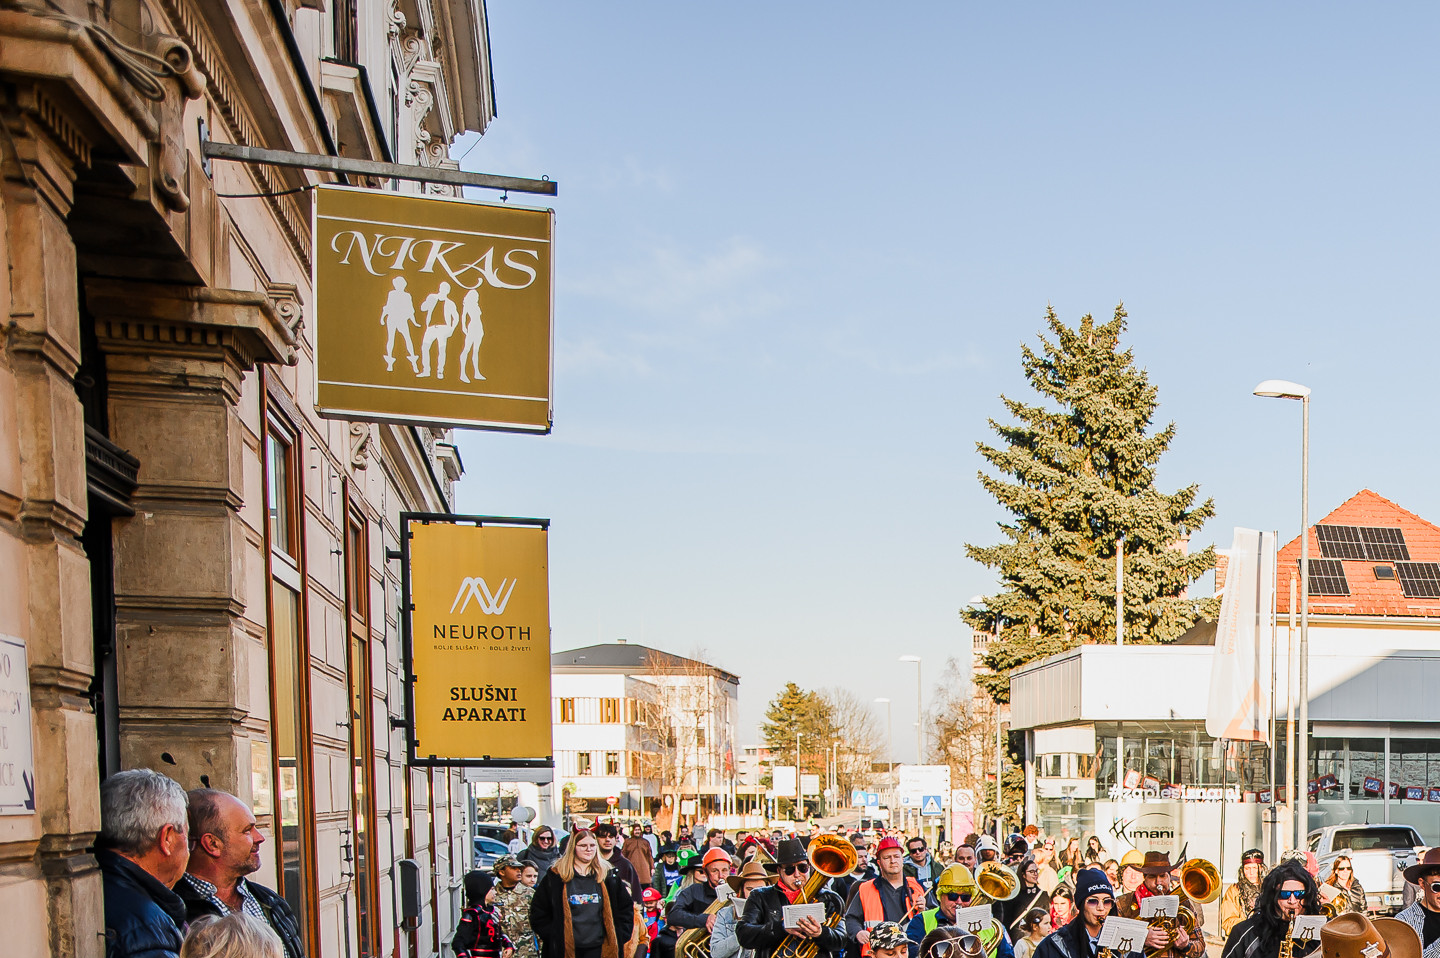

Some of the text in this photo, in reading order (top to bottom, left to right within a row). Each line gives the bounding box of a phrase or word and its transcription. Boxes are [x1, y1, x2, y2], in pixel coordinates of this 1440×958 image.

[331, 230, 540, 290] NIKAS
[433, 624, 531, 641] NEUROTH
[449, 684, 518, 702] SLUŠNI
[441, 707, 527, 722] APARATI
